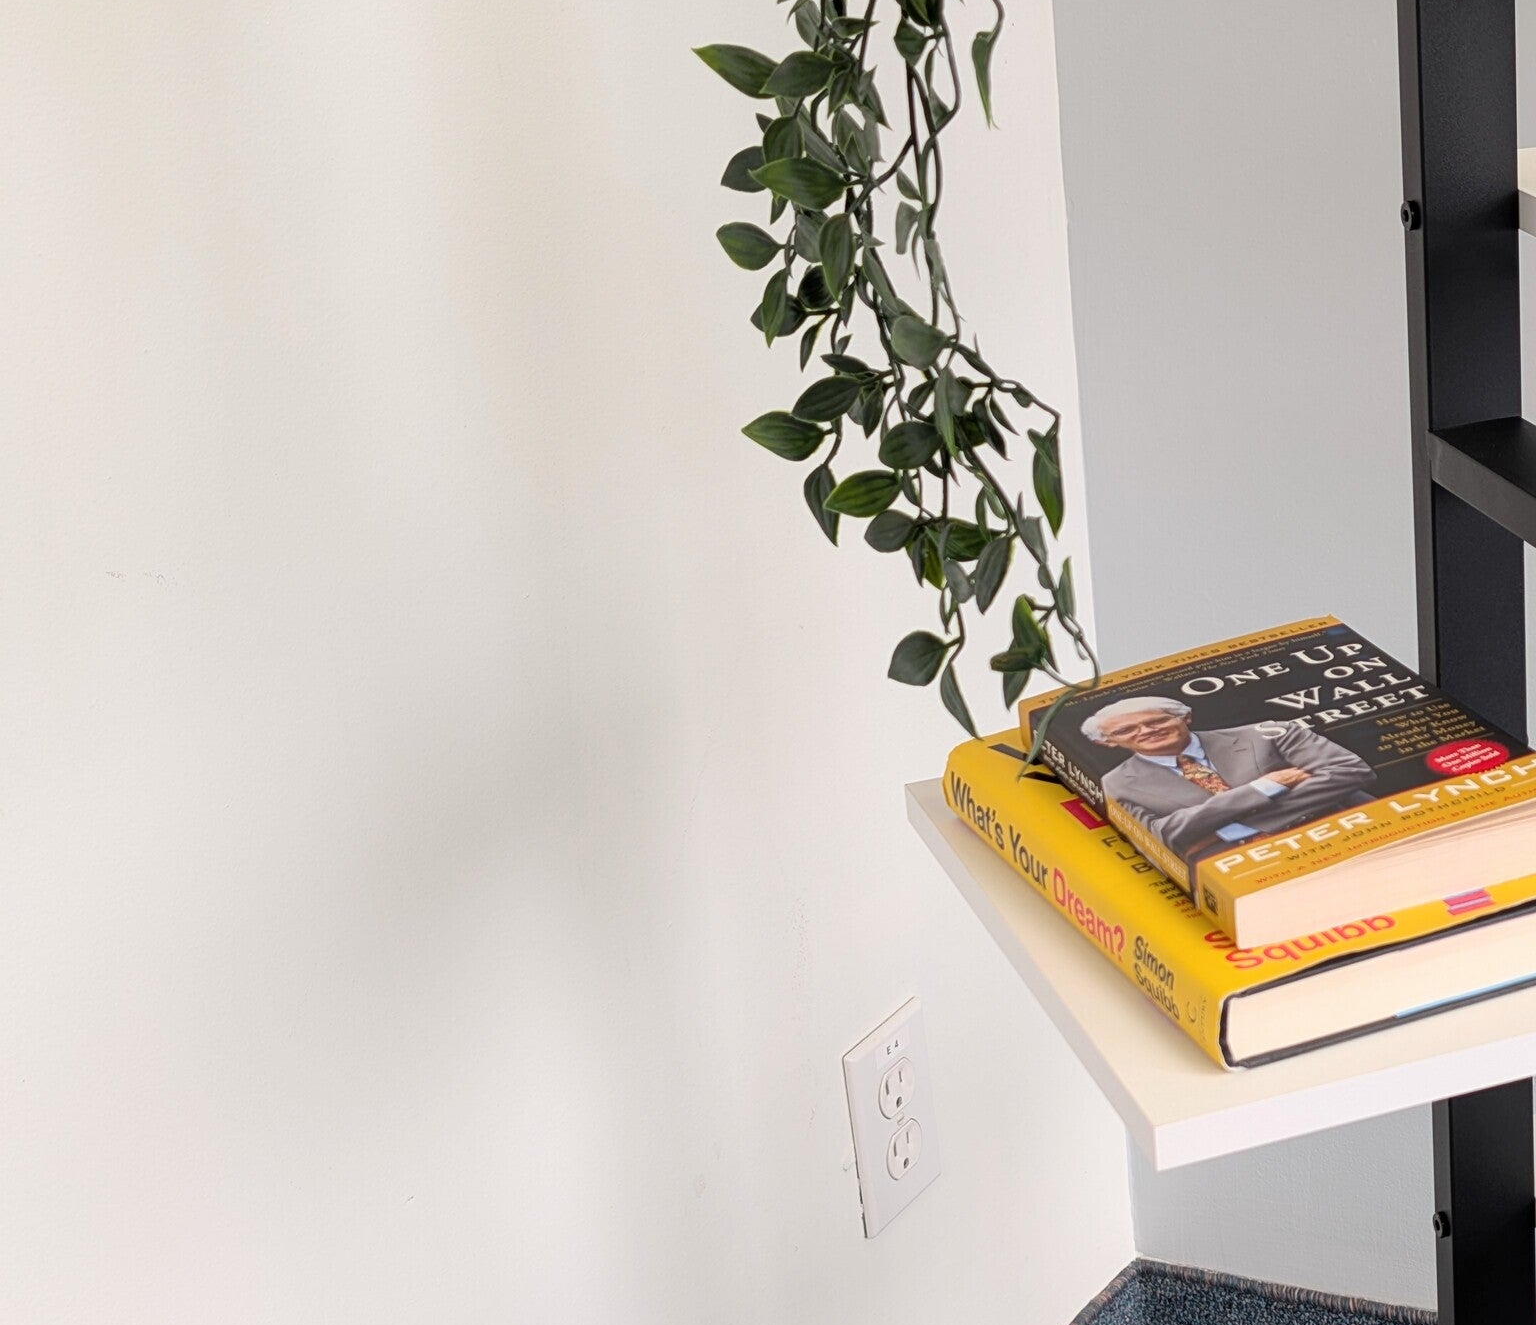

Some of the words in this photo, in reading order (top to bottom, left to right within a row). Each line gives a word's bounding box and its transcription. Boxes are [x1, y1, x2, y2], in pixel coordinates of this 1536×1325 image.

[1121, 664, 1165, 679] YORK
[1171, 648, 1221, 664] TIMES
[1228, 620, 1328, 649] BESTSELLER
[1180, 662, 1290, 695] ONE
[1290, 643, 1363, 665] UP
[1323, 656, 1388, 679] ON
[1264, 672, 1412, 710] WALL
[1254, 685, 1429, 741] STREET
[1375, 714, 1407, 726] How
[1410, 709, 1424, 717] to
[1425, 702, 1451, 712] Use
[1380, 725, 1427, 742] Already
[1430, 714, 1468, 728] Know
[1394, 716, 1431, 728] What
[1433, 708, 1460, 718] You
[1377, 744, 1393, 752] to
[1393, 733, 1431, 746] Make
[1432, 720, 1476, 736] Money
[1415, 740, 1438, 749] the
[1439, 726, 1486, 742] Market
[1434, 752, 1459, 763] More
[1457, 743, 1481, 754] Than
[1441, 758, 1461, 768] One
[1460, 746, 1493, 760] Million
[1451, 758, 1482, 772] Copies
[1067, 761, 1104, 803] LYNCH
[1286, 842, 1333, 861] WITH
[1342, 820, 1393, 843] JOHN
[1400, 786, 1506, 821] ROTHCHILD
[1214, 812, 1375, 874] PETER
[951, 770, 1005, 851] What's
[1009, 824, 1048, 890] Your
[1053, 866, 1126, 964] Dream?
[1134, 935, 1175, 991] Simon
[1134, 963, 1180, 1020] Squibb
[886, 1045, 891, 1056] E
